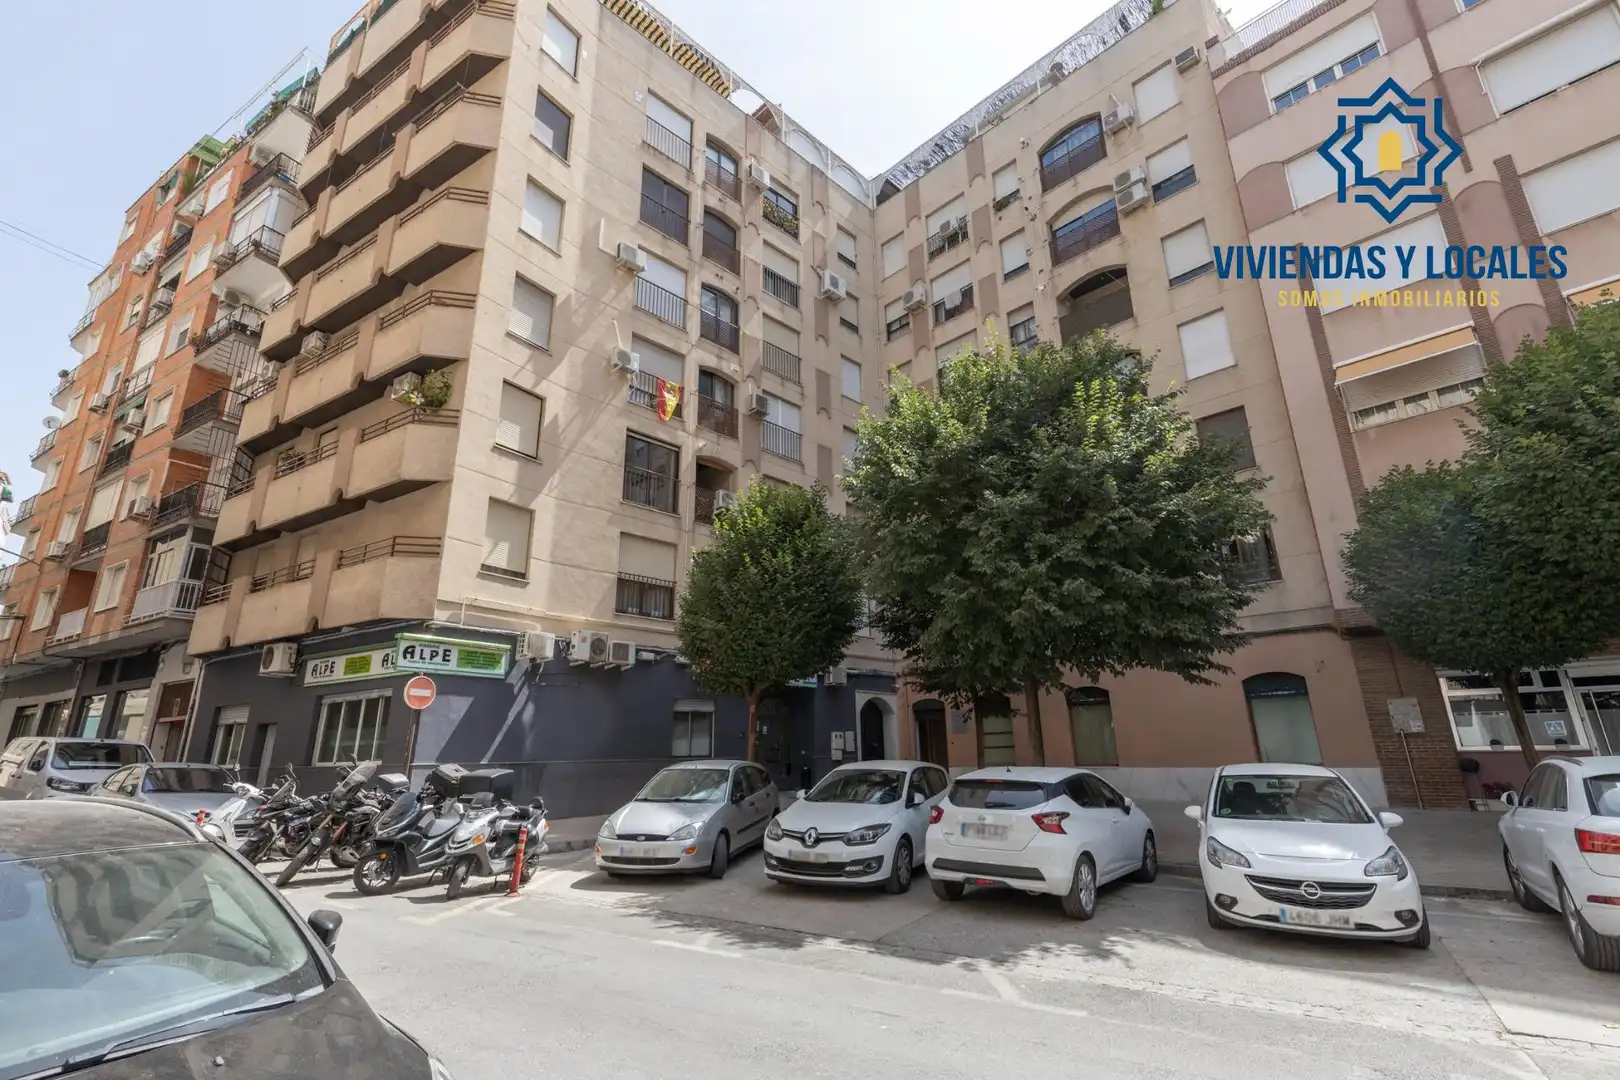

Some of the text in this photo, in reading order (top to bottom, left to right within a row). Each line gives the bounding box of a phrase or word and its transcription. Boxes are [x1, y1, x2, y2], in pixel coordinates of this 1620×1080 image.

[381, 652, 395, 669] AL
[402, 645, 452, 662] ALPE
[311, 661, 336, 678] ALPE
